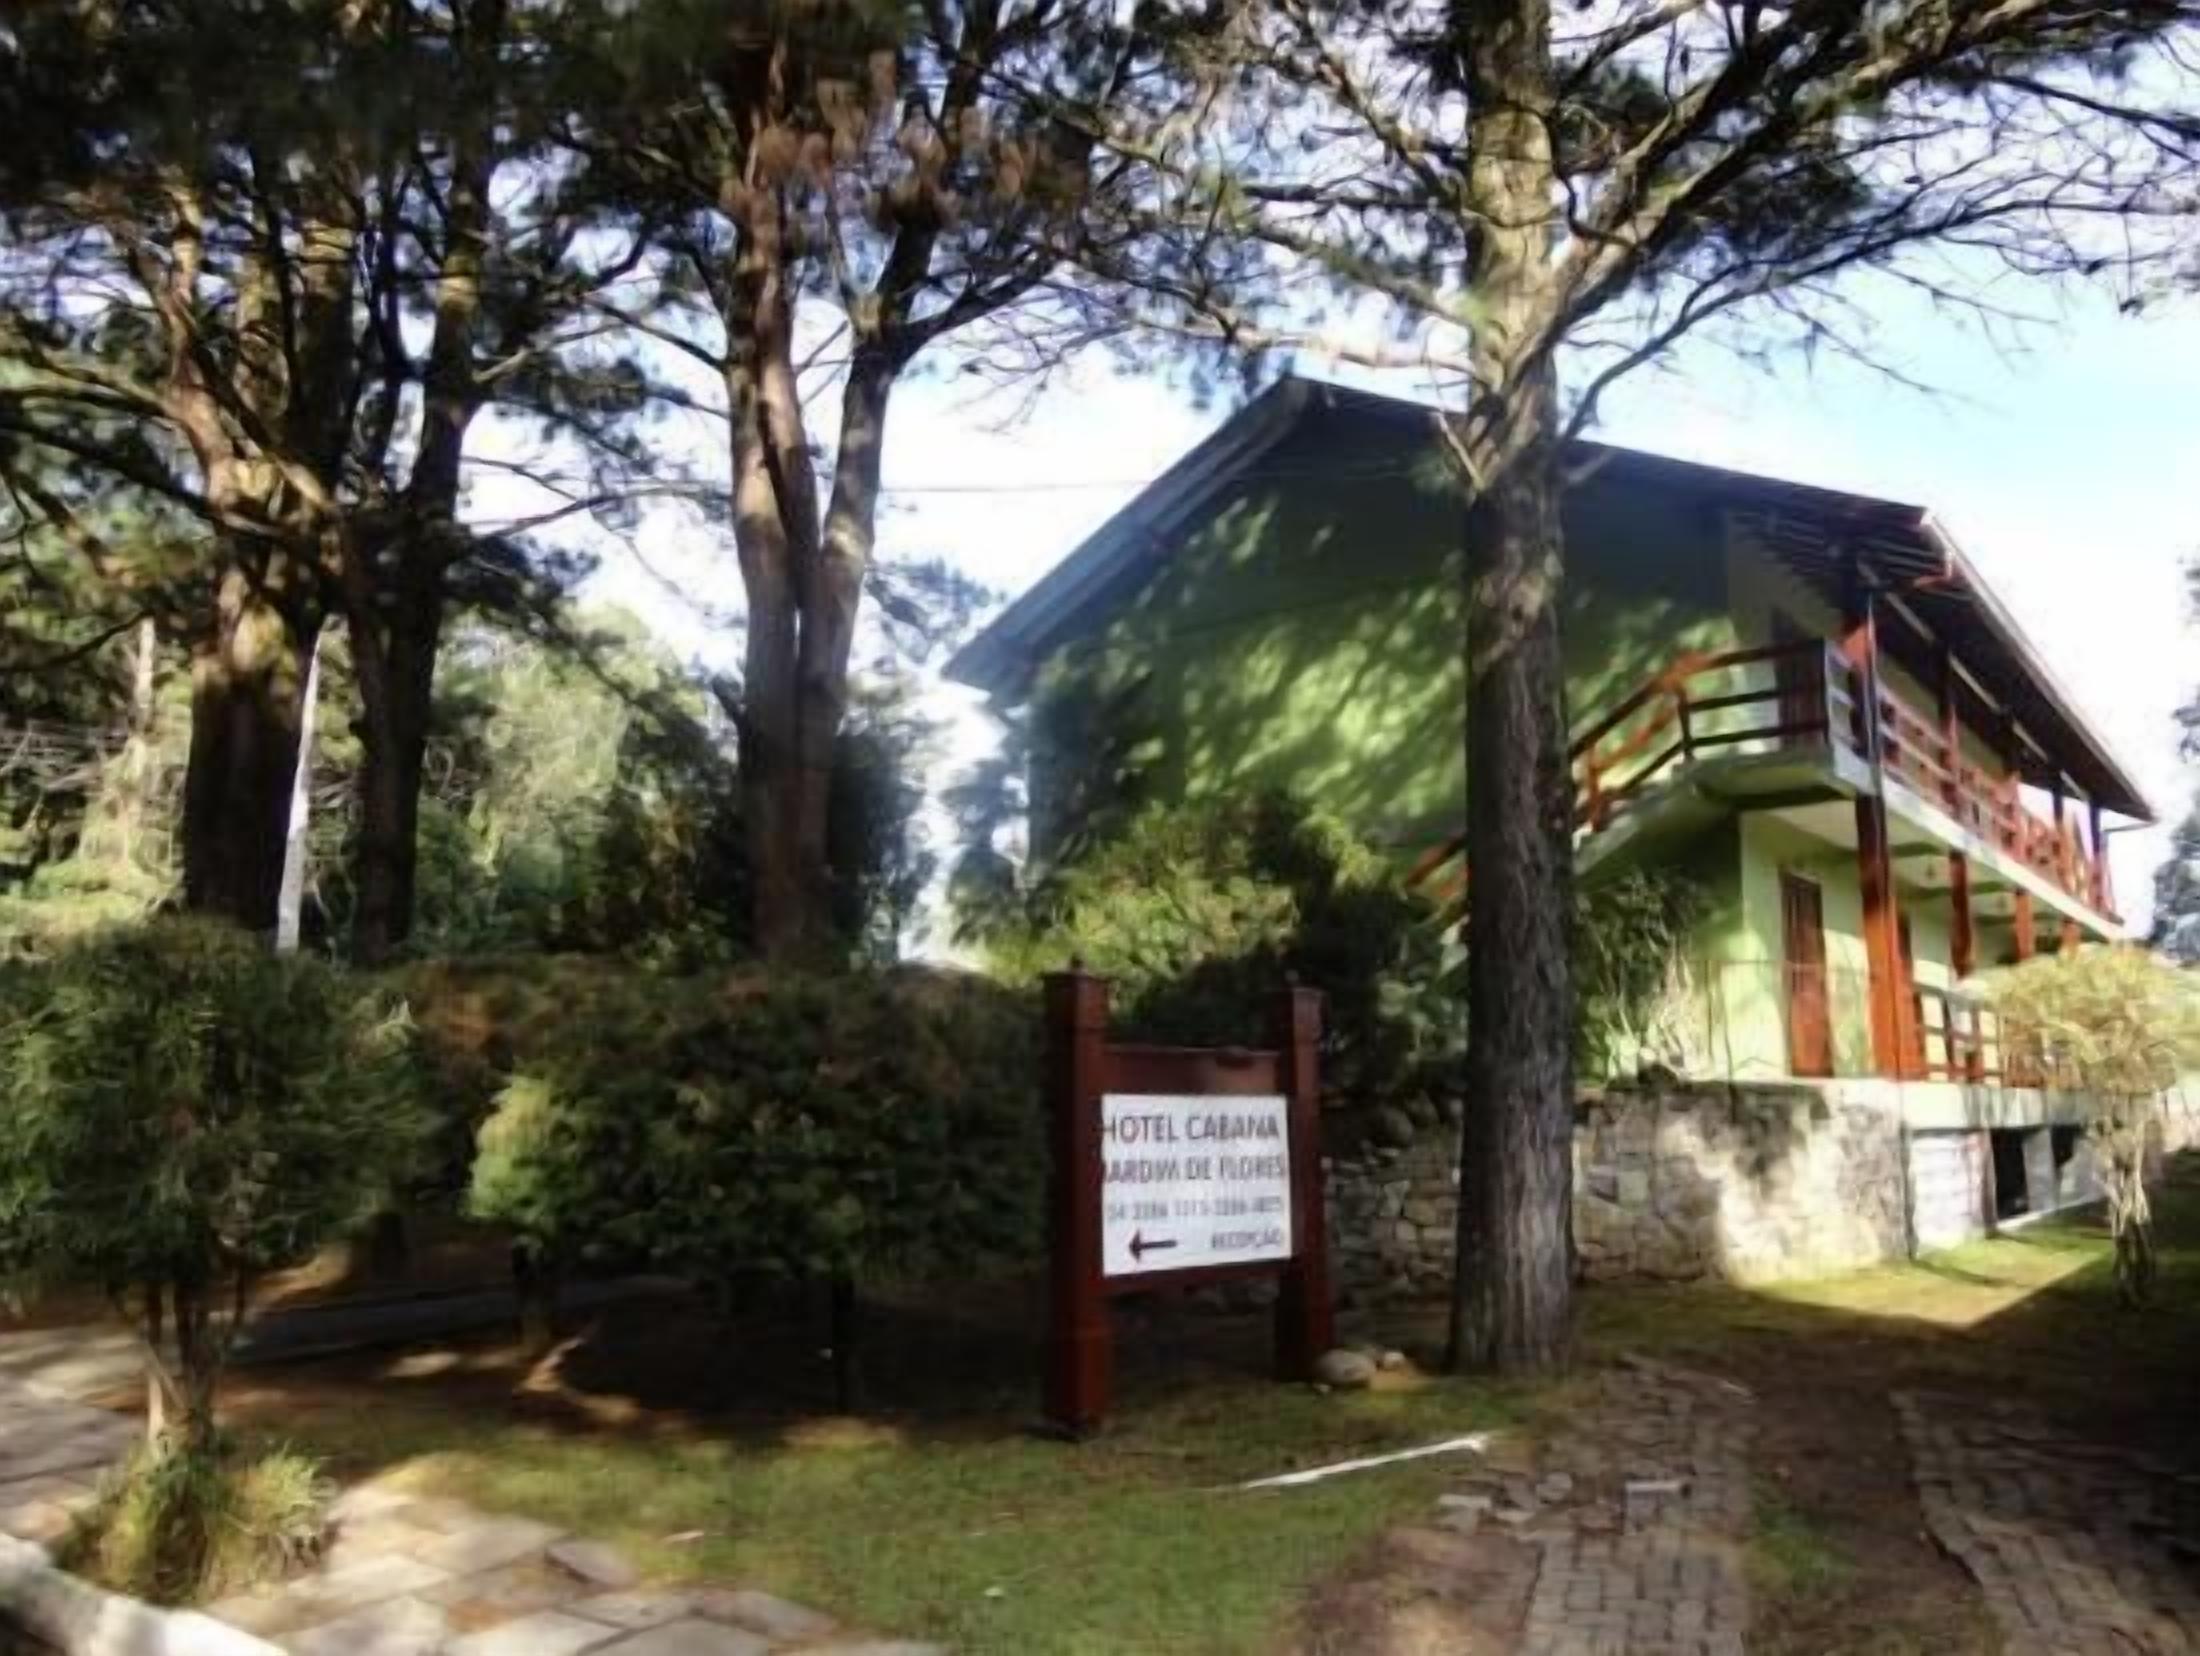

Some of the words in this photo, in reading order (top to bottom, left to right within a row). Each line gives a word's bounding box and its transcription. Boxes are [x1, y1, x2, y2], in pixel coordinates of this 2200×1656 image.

[1103, 1115, 1179, 1143] HOTEL
[1185, 1114, 1280, 1142] CABANA
[1186, 1156, 1212, 1181] DE
[1219, 1154, 1284, 1181] FLORES
